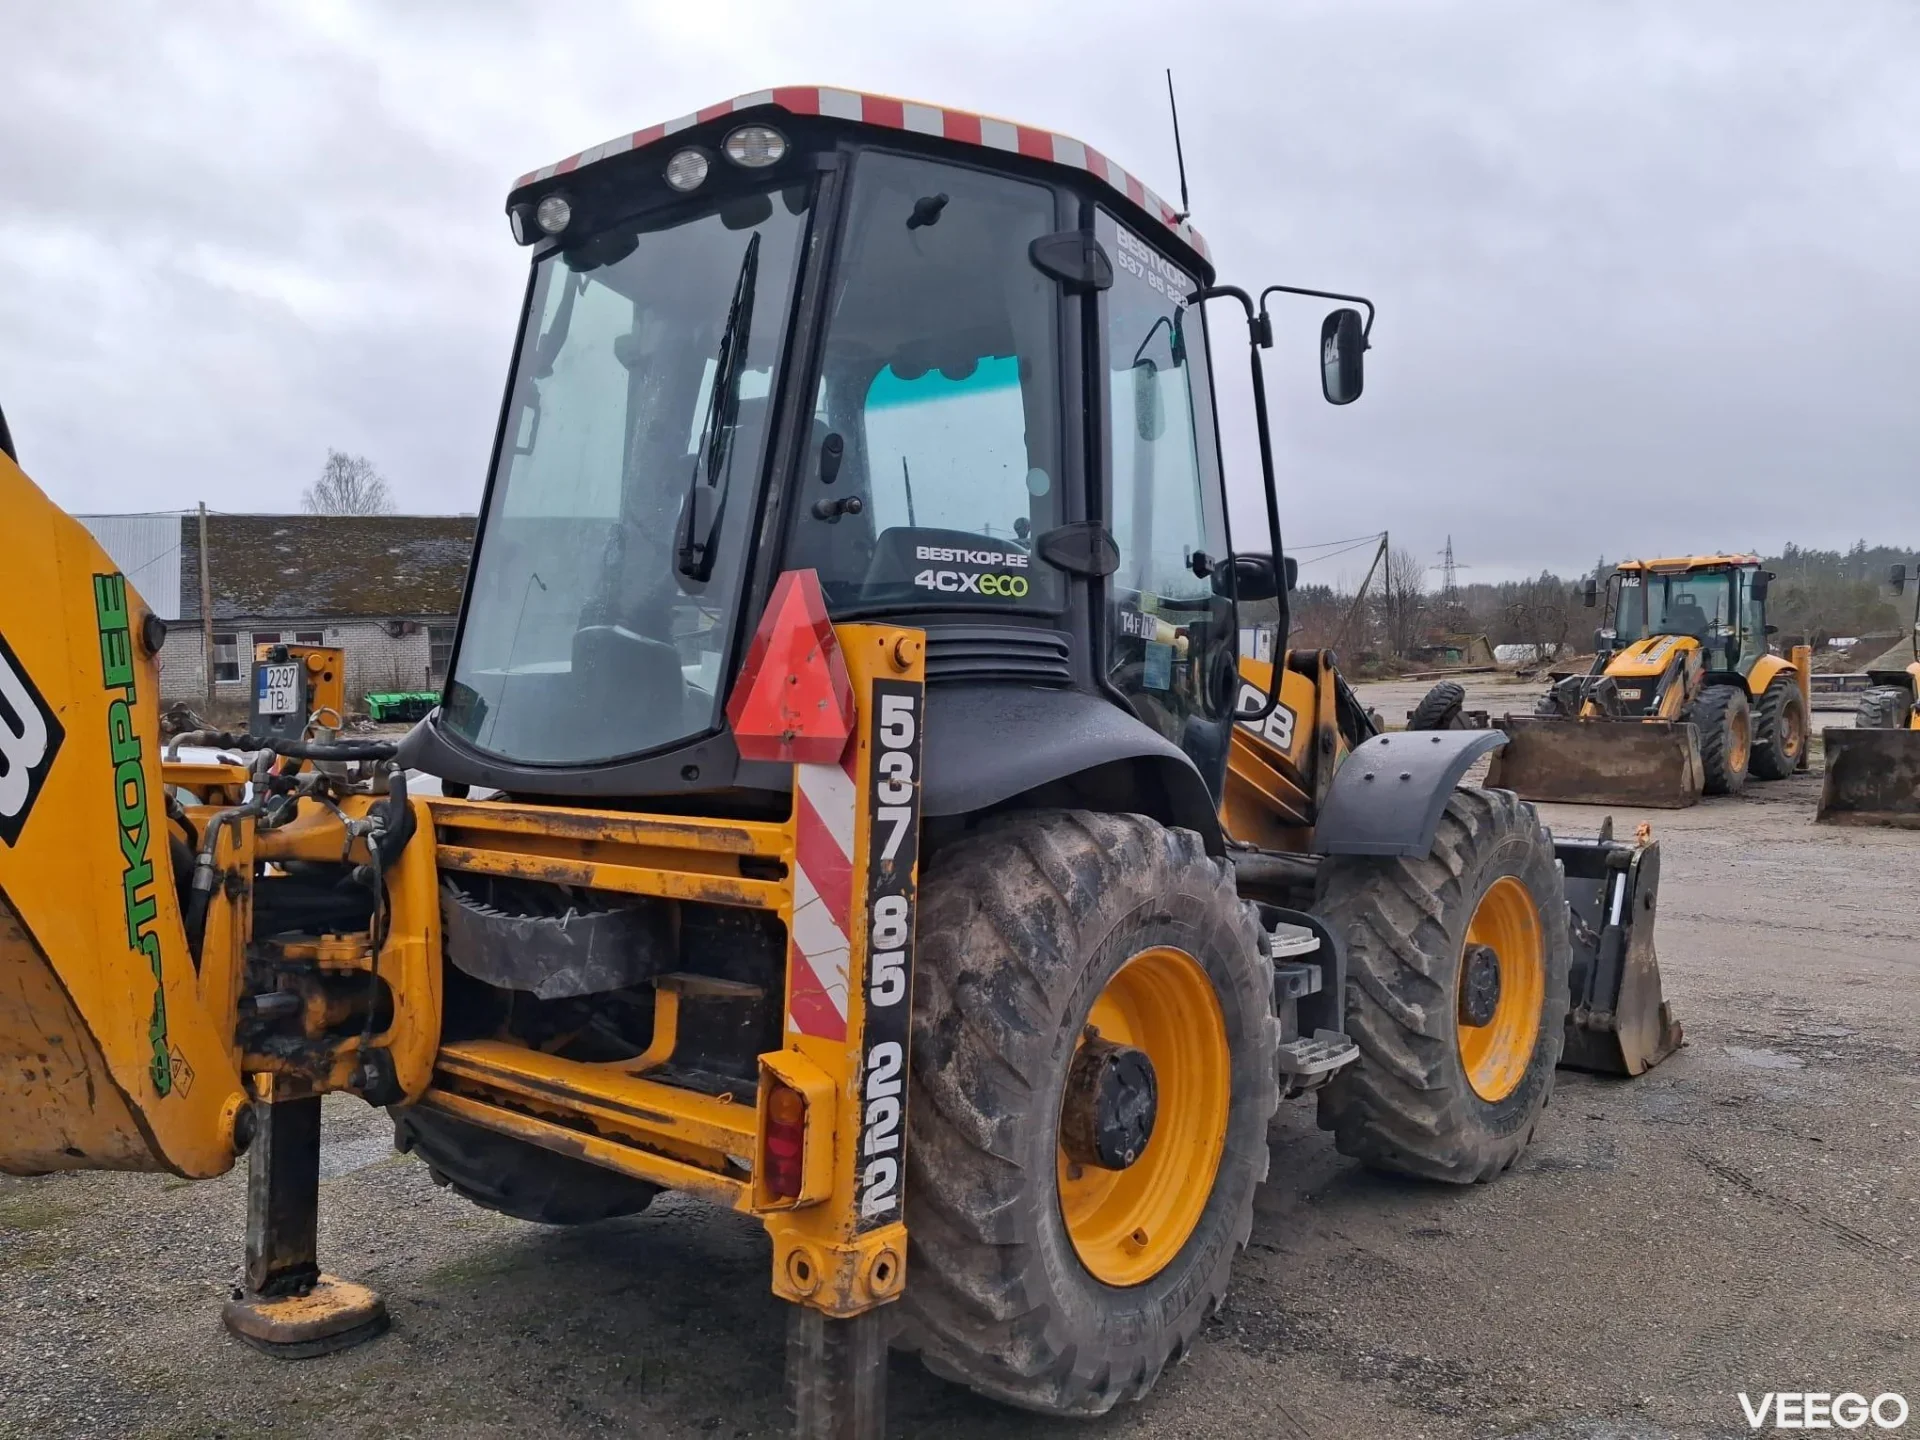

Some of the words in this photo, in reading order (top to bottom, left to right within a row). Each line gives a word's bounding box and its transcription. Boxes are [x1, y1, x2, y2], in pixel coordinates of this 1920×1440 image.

[1116, 223, 1187, 289] BESTKOP
[1117, 249, 1145, 279] 537
[1147, 270, 1165, 294] 85
[1166, 284, 1190, 313] 222
[915, 545, 1029, 568] BESTKOP.EE
[1621, 577, 1641, 587] M2
[268, 667, 296, 689] 2297
[1237, 683, 1294, 749] CB
[878, 694, 915, 865] 537
[869, 895, 909, 1007] 85
[861, 1041, 903, 1218] 222
